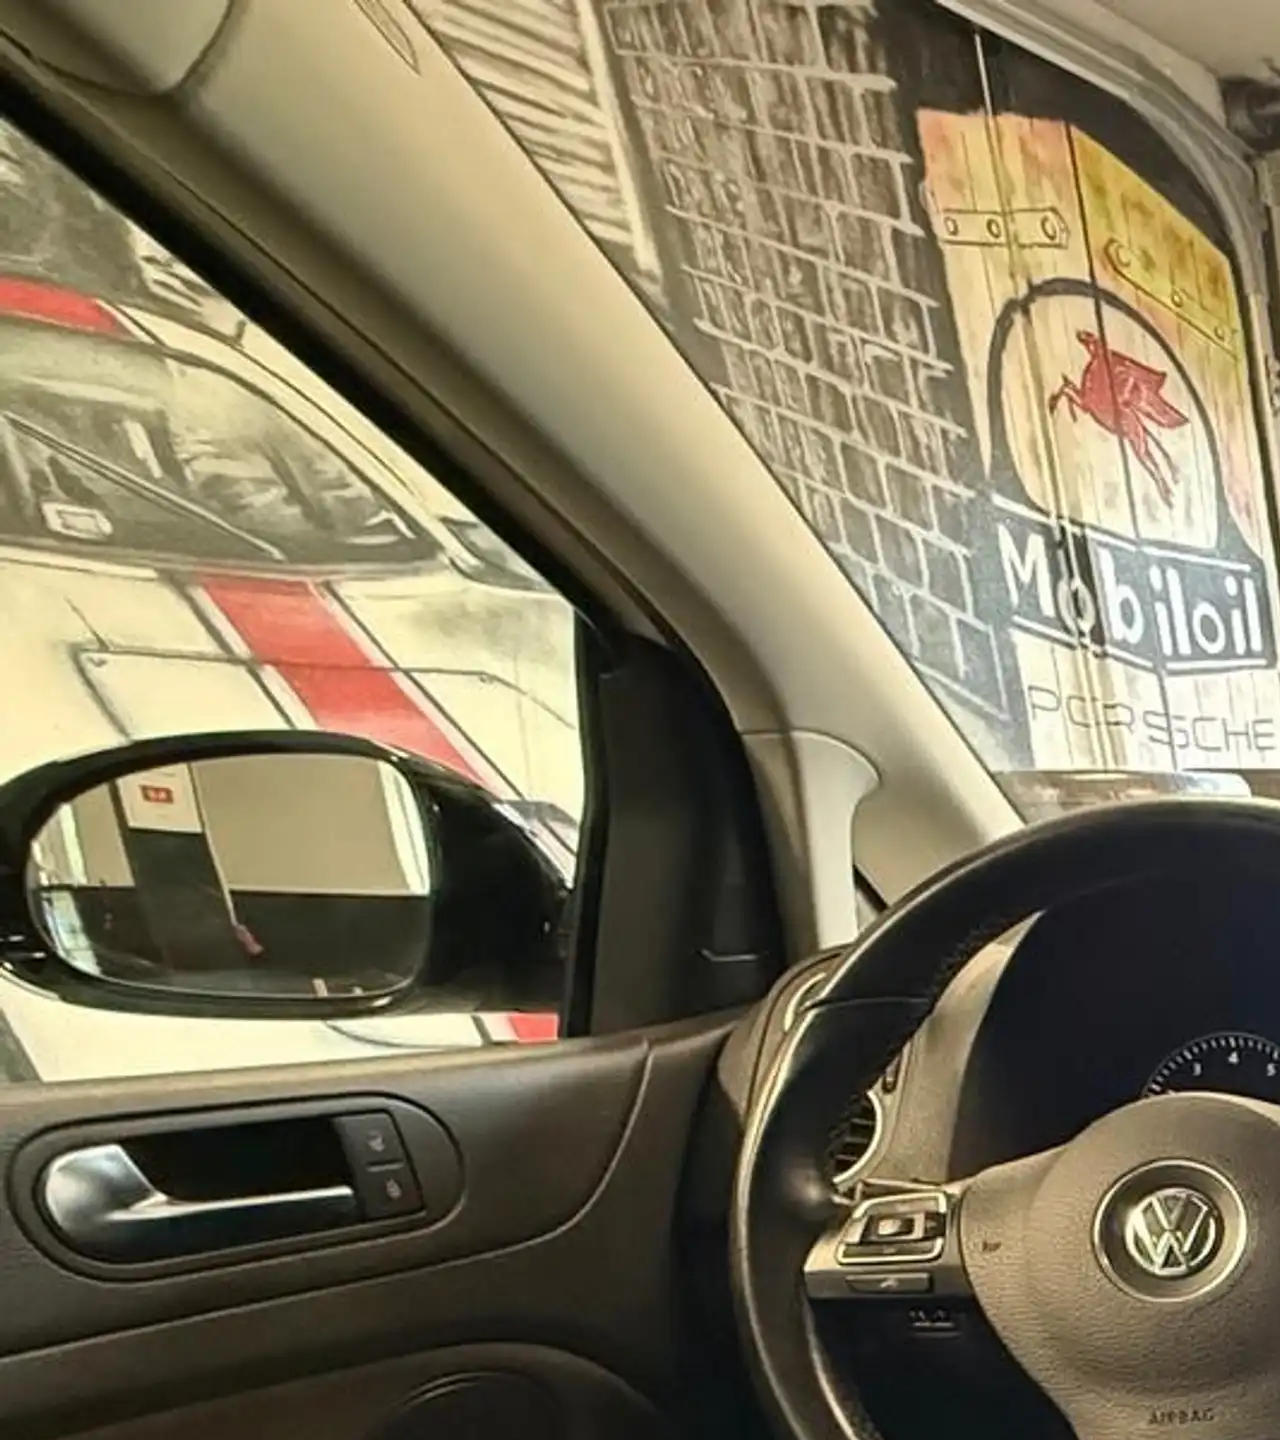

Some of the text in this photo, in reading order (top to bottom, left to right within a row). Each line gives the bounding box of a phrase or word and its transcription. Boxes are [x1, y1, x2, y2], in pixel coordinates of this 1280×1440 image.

[997, 524, 1266, 657] Mobiloil
[1028, 685, 1278, 752] PORSCHE
[1148, 1407, 1214, 1425] AIRBAG
